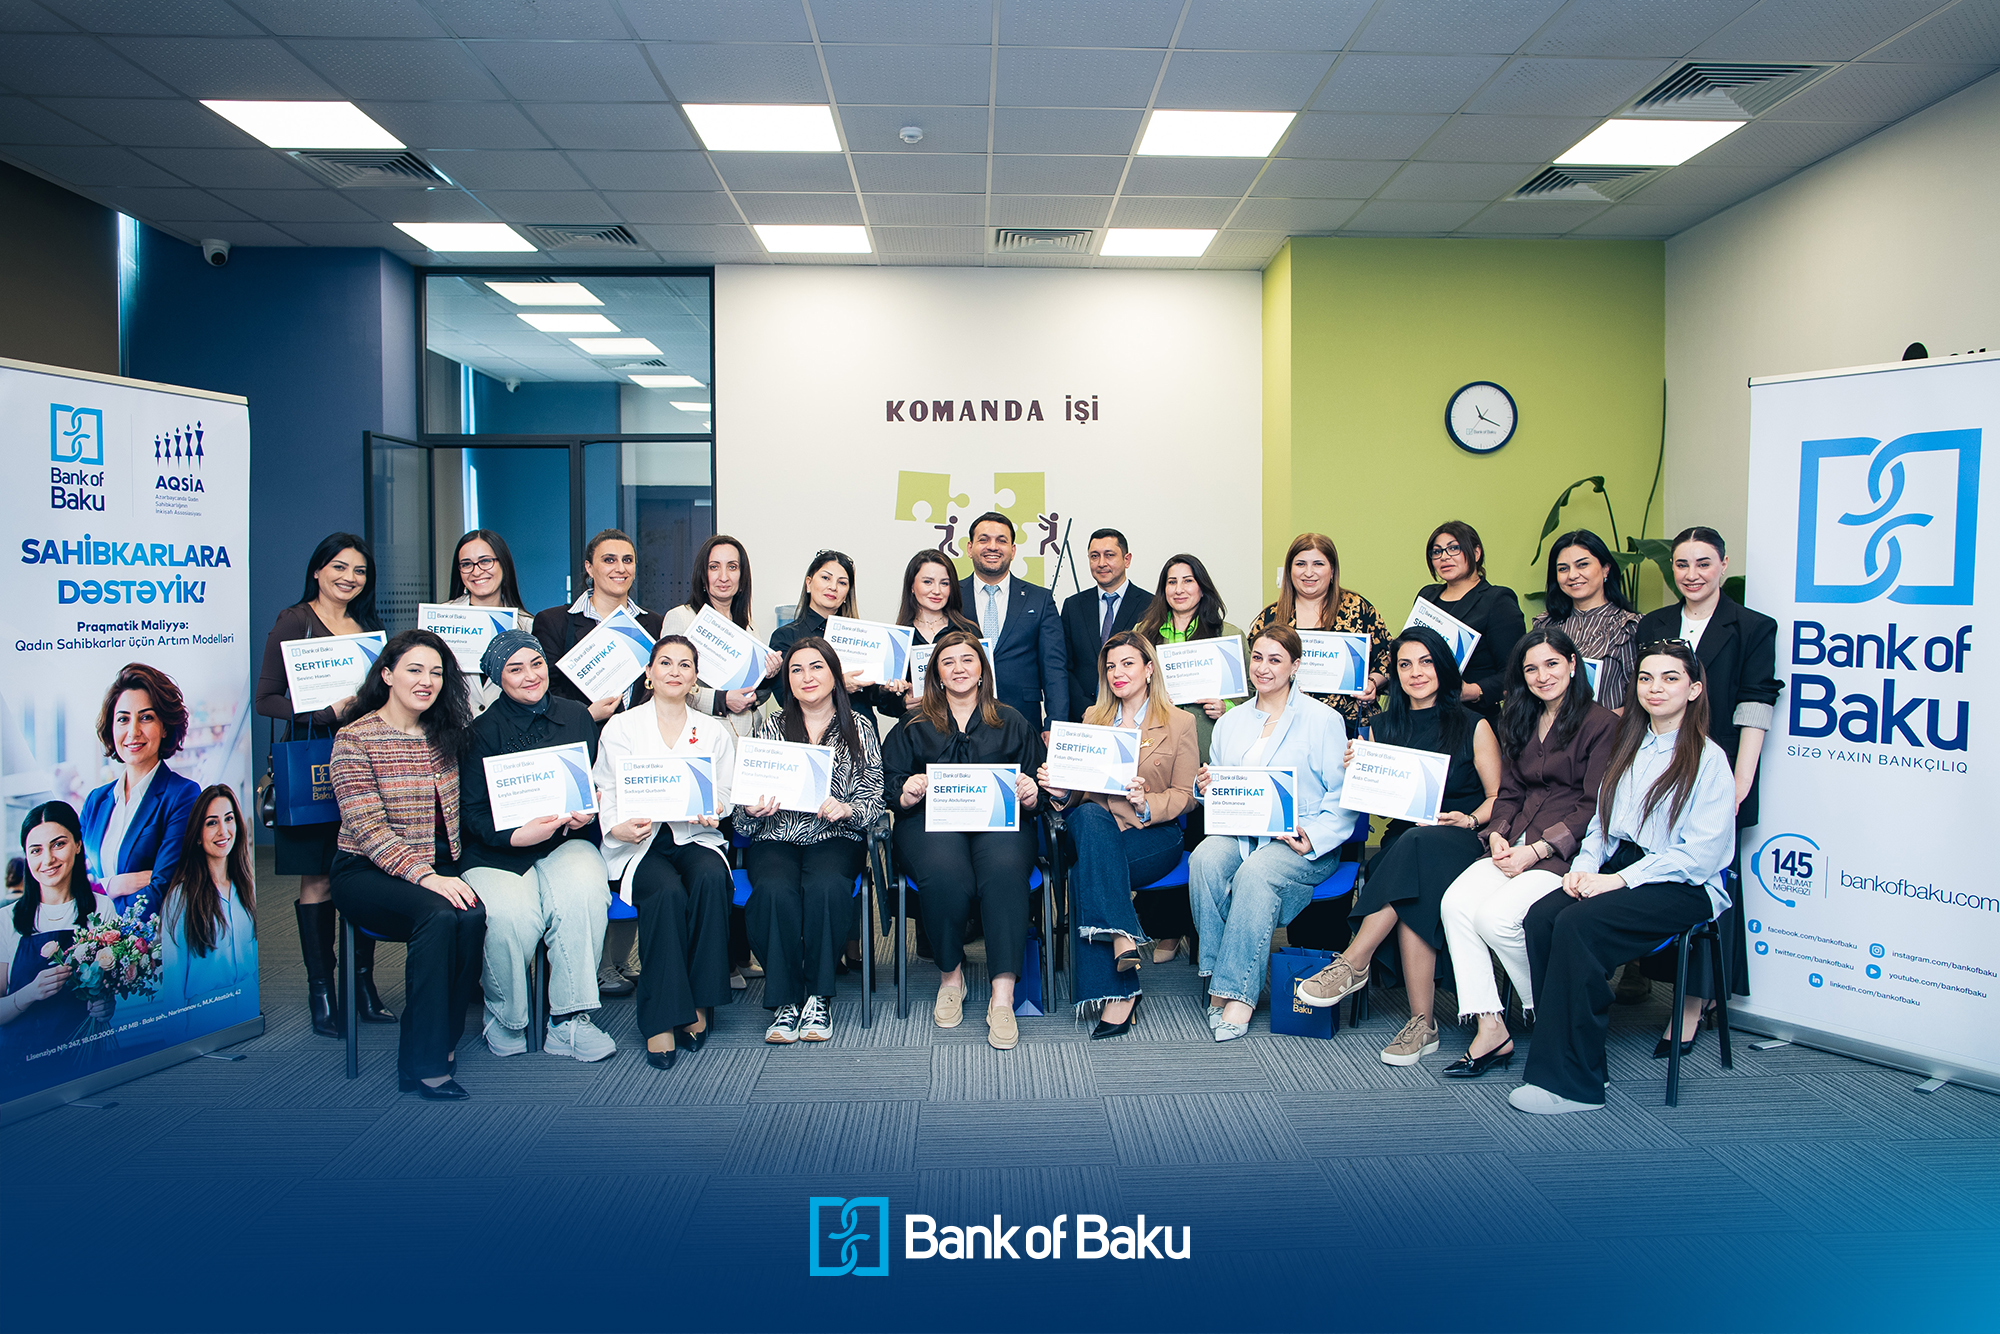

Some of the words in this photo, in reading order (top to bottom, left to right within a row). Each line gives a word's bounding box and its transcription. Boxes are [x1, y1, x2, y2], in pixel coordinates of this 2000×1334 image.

[886, 400, 1044, 422] KOMANDA
[1065, 395, 1098, 424] İŞİ
[50, 466, 88, 486] Bank
[90, 471, 104, 488] of
[155, 474, 204, 492] AQSİA
[50, 486, 105, 511] Baku
[21, 533, 232, 568] SAHİBKARLARA
[58, 574, 206, 604] DƏSTƏYİK!
[77, 620, 139, 634] Praqmatik
[141, 620, 188, 632] Maliyyə:
[427, 625, 484, 635] SERTİFİKAT
[16, 639, 53, 652] Qadın
[57, 637, 126, 650] Sahibkarlar
[128, 636, 155, 649] üçün
[158, 635, 190, 646] Artım
[192, 634, 234, 646] Modelləri
[696, 626, 742, 658] SERTİFİKAT
[831, 636, 881, 649] SERTİFİKAT
[1791, 620, 1919, 670] Bank
[1924, 624, 1972, 672] of
[576, 641, 616, 679] SERTİFİKAT
[1302, 649, 1339, 658] RTİFİKAT
[294, 657, 354, 672] SERTİFİKAT
[1166, 658, 1214, 670] SERTİFİKAT
[1788, 673, 1969, 752] Baku
[1056, 742, 1107, 754] SERTİFİKAT
[743, 758, 799, 772] SERTİFİKAT
[1787, 744, 1822, 758] SİZƏ
[1828, 750, 1872, 764] YAXIN
[1878, 754, 1968, 774] BANKÇILIQ
[496, 770, 555, 788] SERTİFİKAT
[624, 774, 681, 784] SERTİFİKAT
[313, 792, 333, 800] Baku
[934, 784, 988, 794] SERTİFİKAT
[1212, 786, 1264, 796] SERTİFİKAT
[1772, 848, 1812, 878] 145
[1774, 876, 1812, 888] MƏLUMAT
[1841, 870, 2000, 912] bankofbaku.com
[1768, 926, 1858, 950] facebook.com/bankofbaku
[1775, 948, 1854, 970] twitter.com/bankofbaku
[1892, 950, 1998, 978] instagram.com/bankofbaku
[1830, 981, 1920, 1006] linkedin.com/bankofbaku
[1889, 972, 1987, 998] youtube.com/bankofbaku
[1293, 1004, 1312, 1014] Baku
[26, 1048, 56, 1062] Lisenziya
